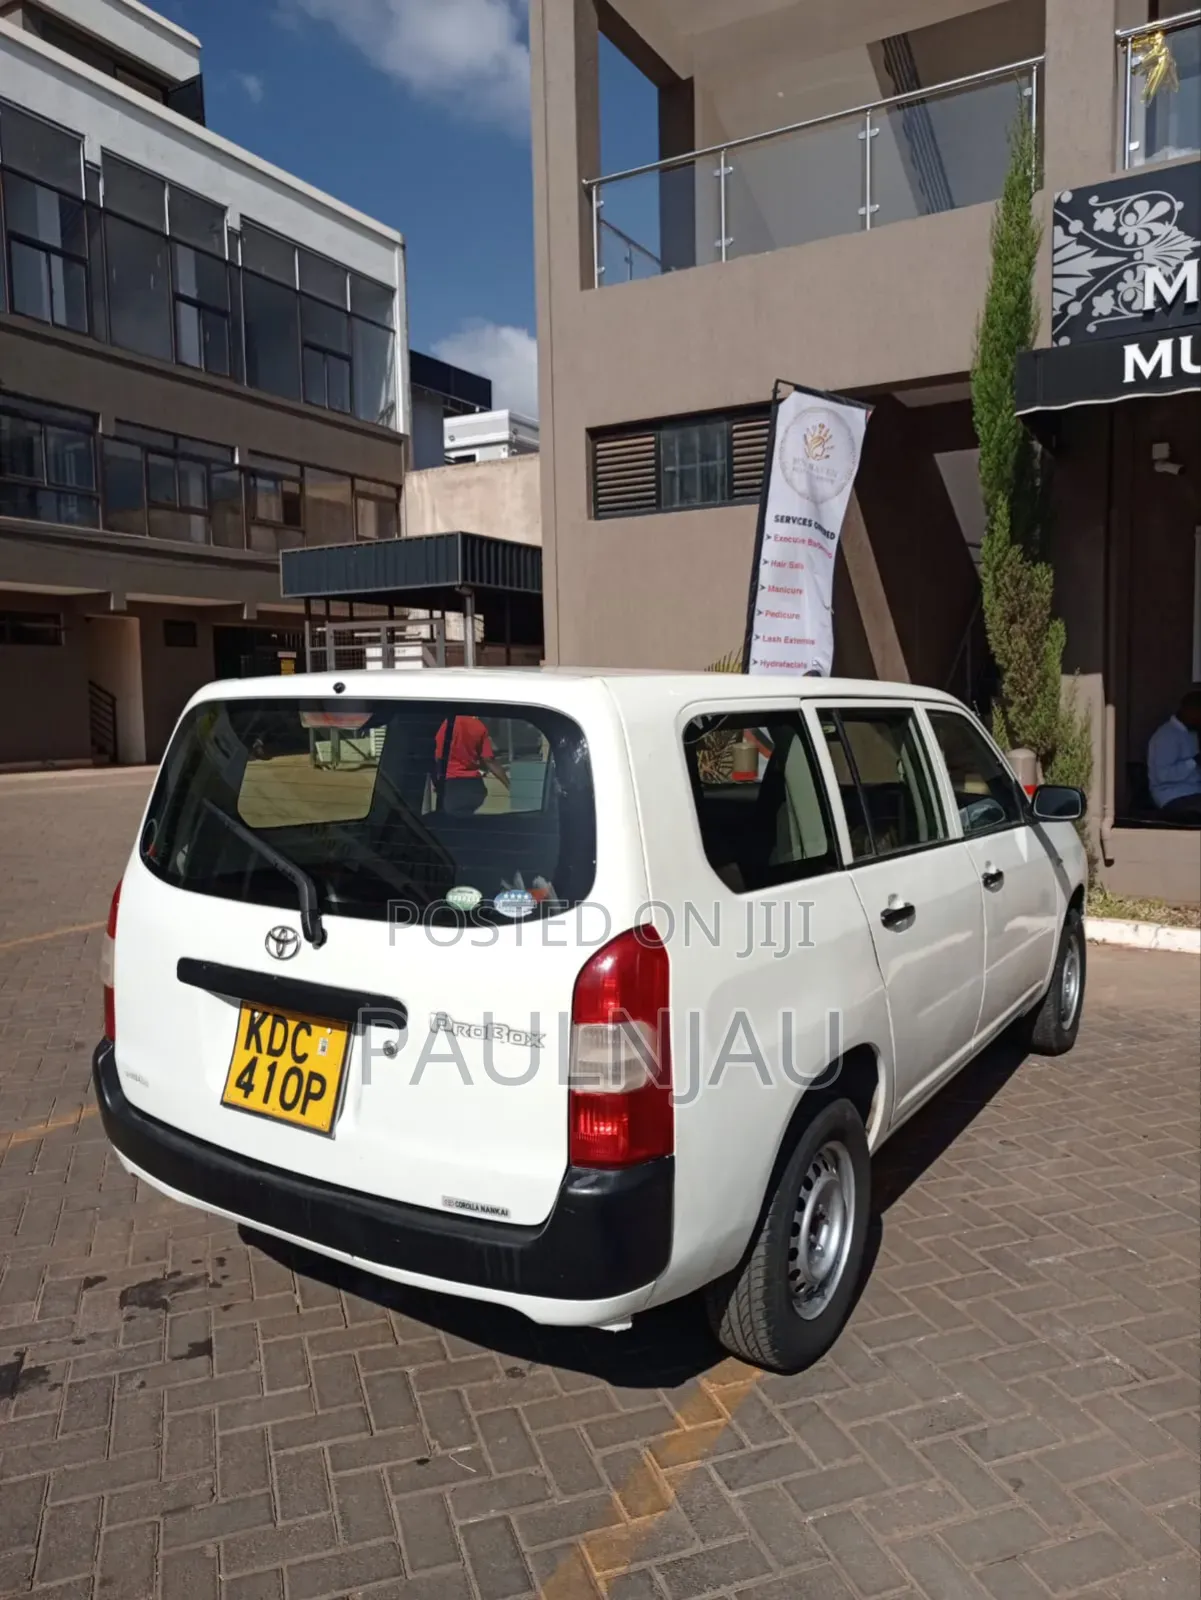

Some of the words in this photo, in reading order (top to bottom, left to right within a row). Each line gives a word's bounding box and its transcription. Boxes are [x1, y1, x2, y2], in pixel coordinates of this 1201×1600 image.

[1122, 335, 1201, 383] MU
[764, 610, 800, 620] Pedicure
[244, 1009, 313, 1065] KDC
[235, 1056, 328, 1116] 410P
[454, 1200, 480, 1212] COROLLA
[480, 1204, 509, 1217] NANKAI
